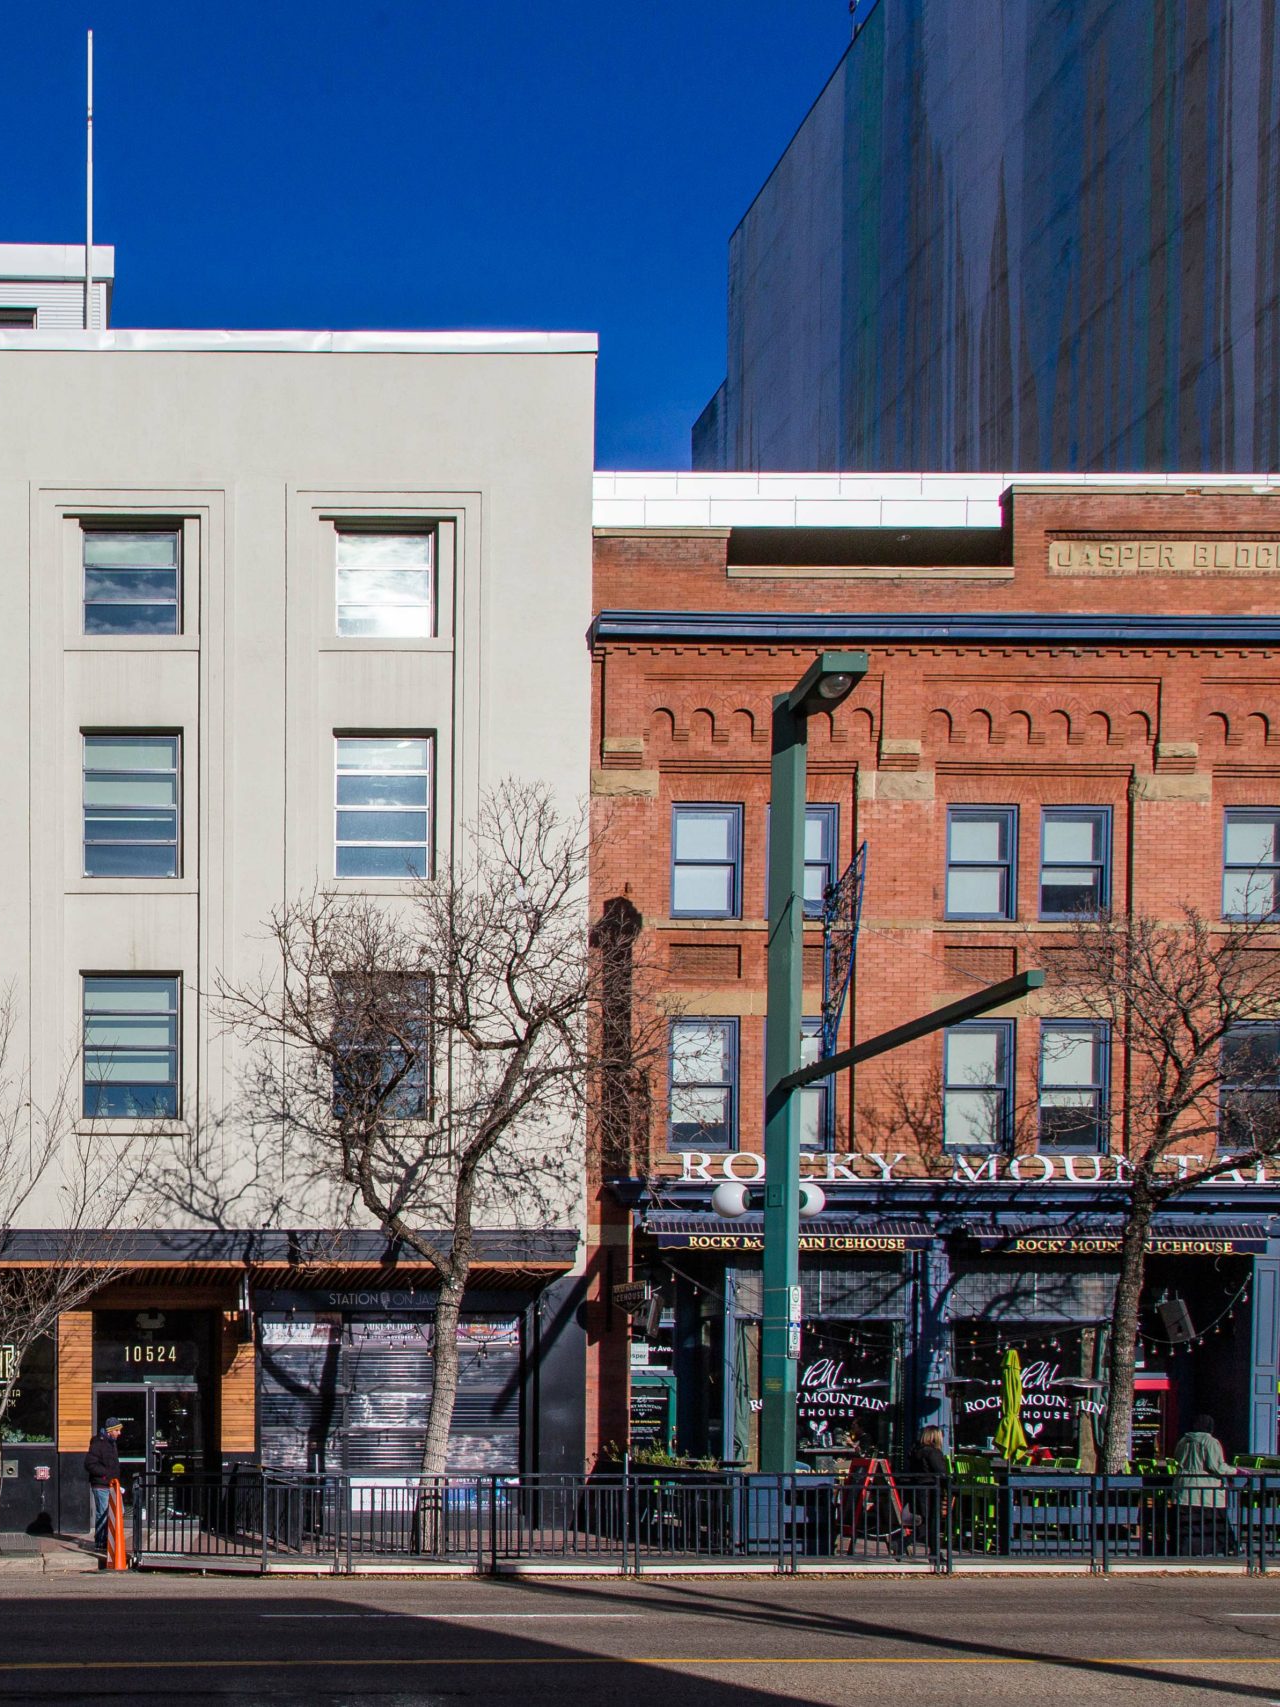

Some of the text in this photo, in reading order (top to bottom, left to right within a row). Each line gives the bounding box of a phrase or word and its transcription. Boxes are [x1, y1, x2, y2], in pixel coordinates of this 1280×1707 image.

[1056, 543, 1280, 568] JASPER BLOC
[689, 1236, 740, 1249] ROCKY
[829, 1237, 906, 1250] ICEHOUSE
[1016, 1240, 1066, 1251] ROCKY
[1157, 1241, 1233, 1253] ICEHOUSE
[329, 1293, 378, 1305] STATION
[392, 1293, 413, 1305] ON
[124, 1345, 177, 1362] 10524
[804, 1391, 889, 1411] MOUNTAIN
